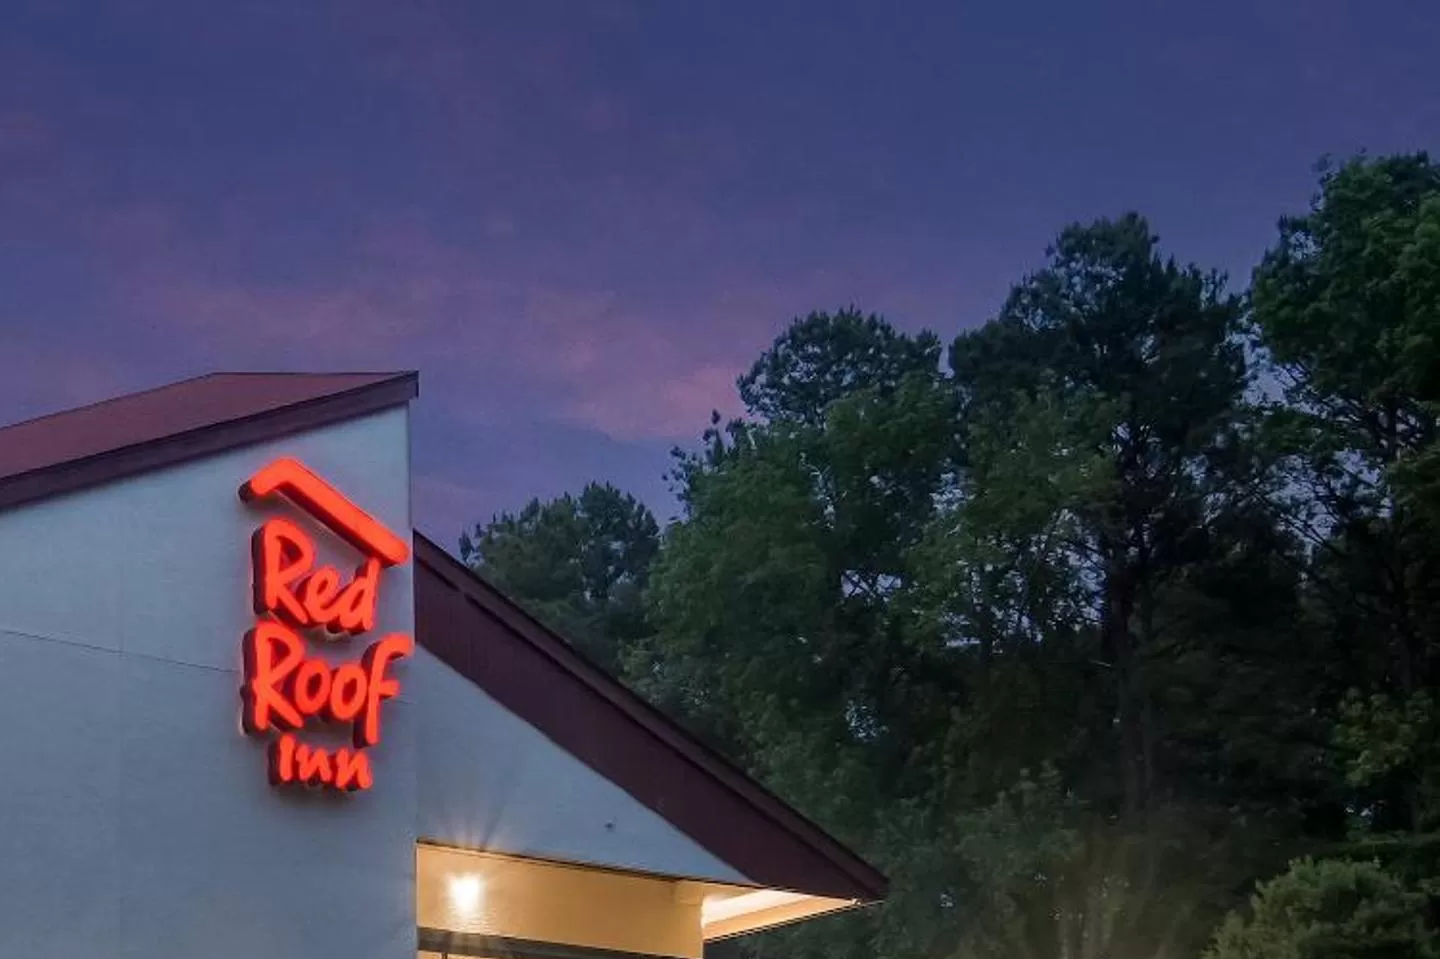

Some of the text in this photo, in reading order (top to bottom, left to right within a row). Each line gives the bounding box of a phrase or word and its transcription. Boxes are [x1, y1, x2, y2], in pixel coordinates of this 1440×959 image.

[260, 517, 381, 633] Red
[251, 619, 414, 745] Roof
[277, 734, 373, 790] Inn
